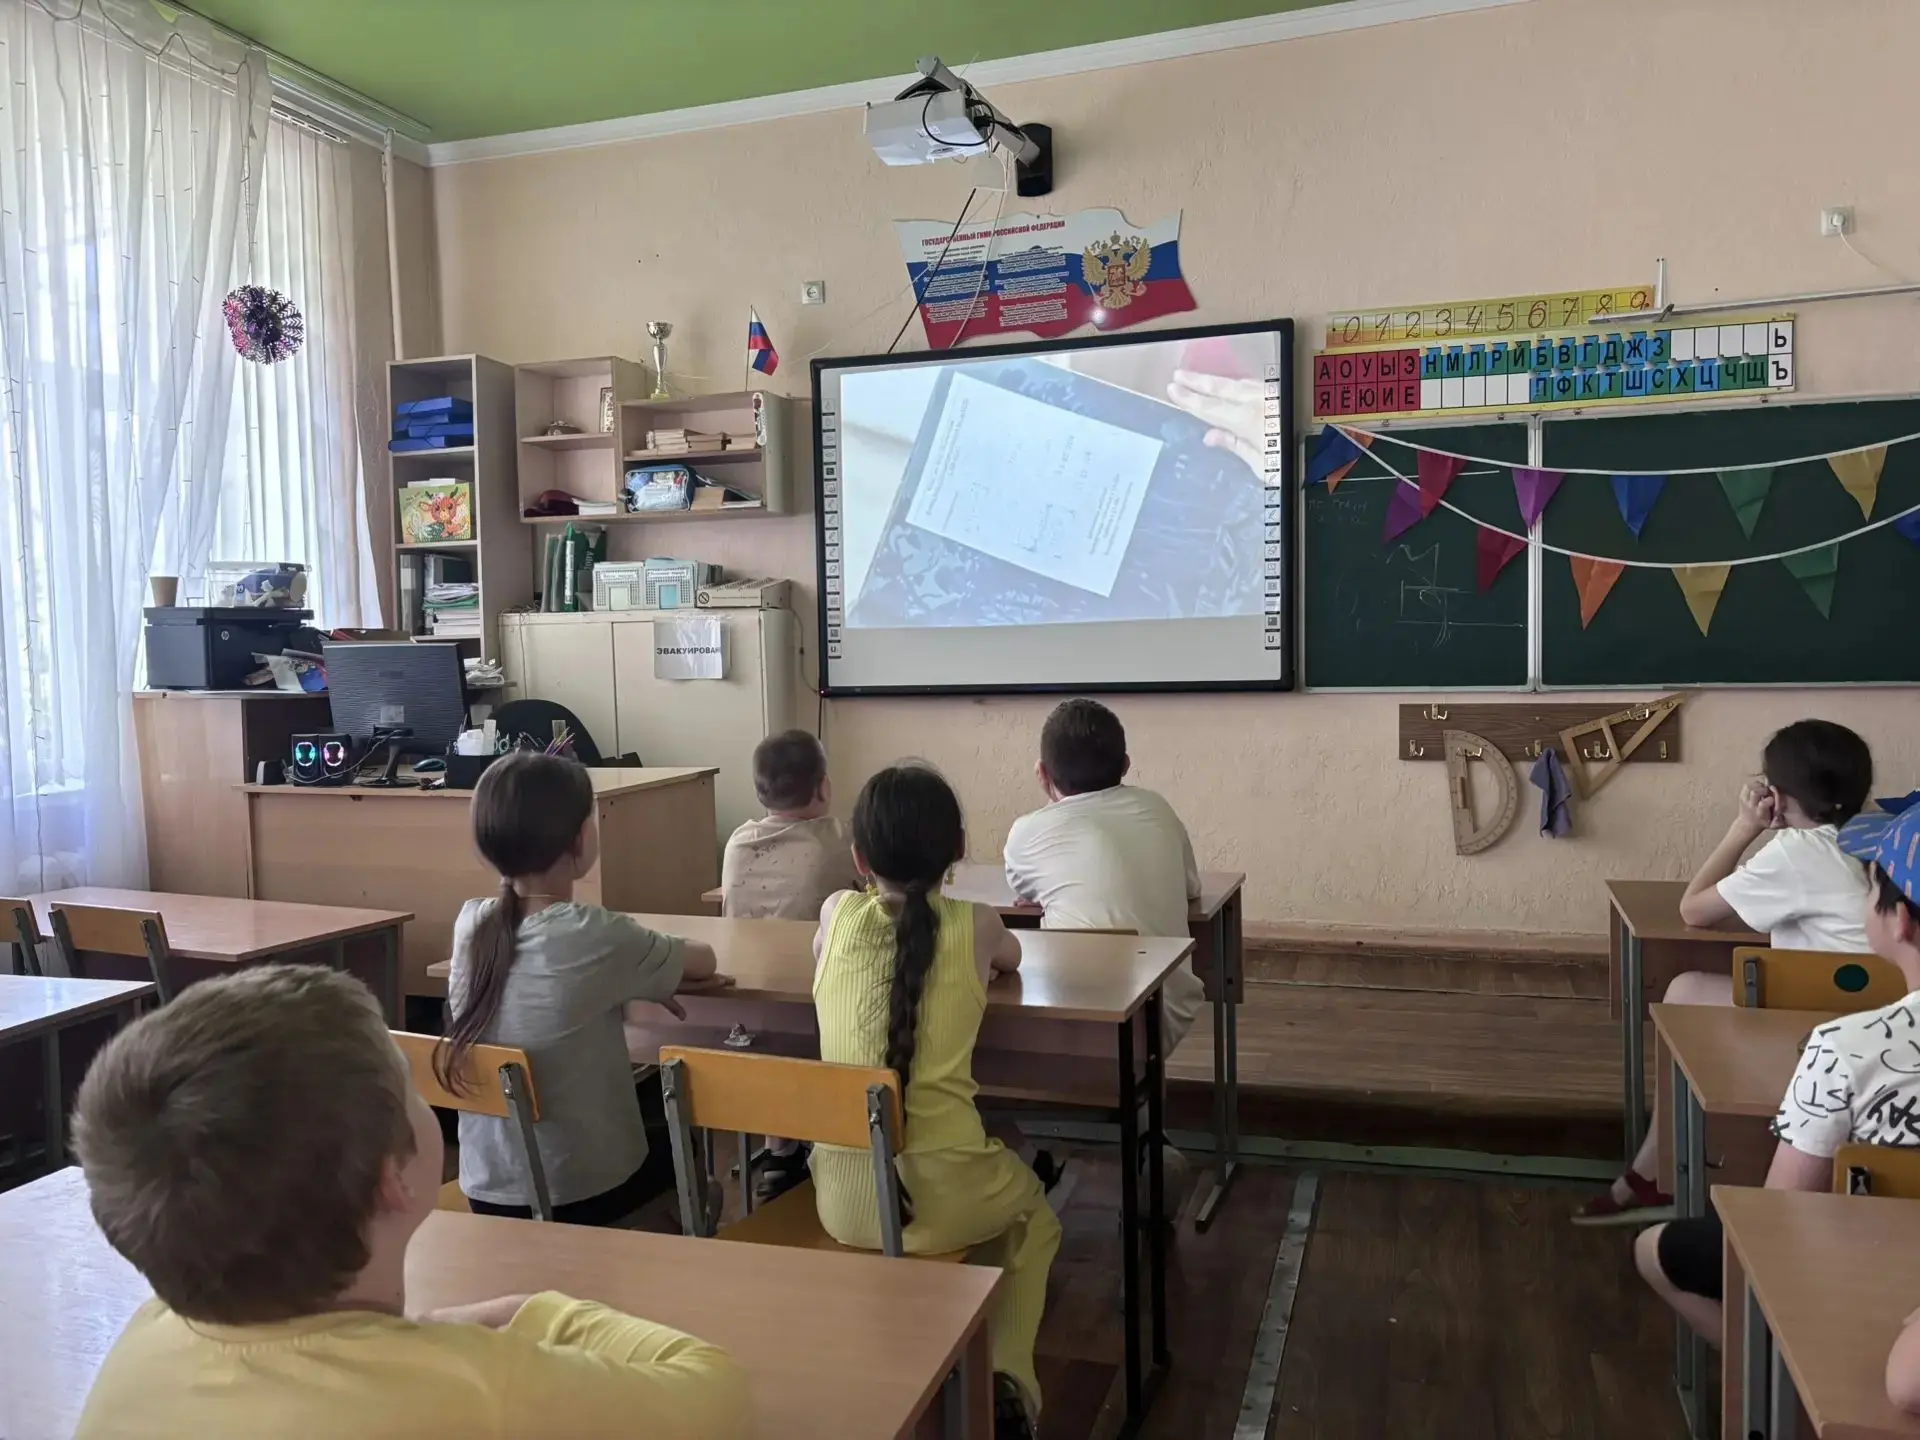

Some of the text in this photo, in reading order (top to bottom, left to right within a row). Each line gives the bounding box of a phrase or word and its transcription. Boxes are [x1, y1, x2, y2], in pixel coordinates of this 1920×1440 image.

[1031, 220, 1065, 232] ФЕДЕРАЦИИ
[1343, 316, 1360, 343] 0
[1376, 314, 1391, 341] 1
[1405, 312, 1421, 338] 2
[1435, 309, 1452, 336] 3
[1466, 306, 1482, 333] 4
[1497, 303, 1514, 331] 5
[1528, 300, 1547, 328] 6
[1563, 297, 1579, 326] 7
[1320, 361, 1330, 380] А
[1340, 360, 1352, 379] О
[1363, 359, 1372, 377] У
[1381, 357, 1396, 376] Ы
[1404, 356, 1415, 375] Э
[1426, 354, 1436, 373] Н
[1447, 353, 1459, 372] М
[1469, 351, 1480, 370] Л
[1492, 350, 1502, 369] Р
[1536, 346, 1548, 366] Б
[1559, 345, 1570, 364] В
[1583, 343, 1593, 362] Г
[1604, 341, 1617, 364] Д
[1627, 338, 1643, 359] Ж
[1653, 337, 1664, 357] З
[1774, 328, 1787, 348] Ь
[1319, 391, 1330, 409] Я
[1341, 386, 1351, 408] Ё
[1359, 388, 1375, 407] Ю
[1383, 387, 1394, 405] И
[1405, 386, 1415, 405] Е
[1557, 376, 1571, 394] Ф
[1583, 374, 1593, 393] К
[1605, 373, 1616, 391] Т
[1626, 371, 1642, 390] Ш
[1652, 369, 1664, 388] С
[1676, 367, 1688, 387] Х
[1701, 365, 1713, 388] Ц
[1725, 362, 1737, 383] Ч
[1747, 362, 1765, 385] Щ
[1772, 361, 1788, 380] Ъ
